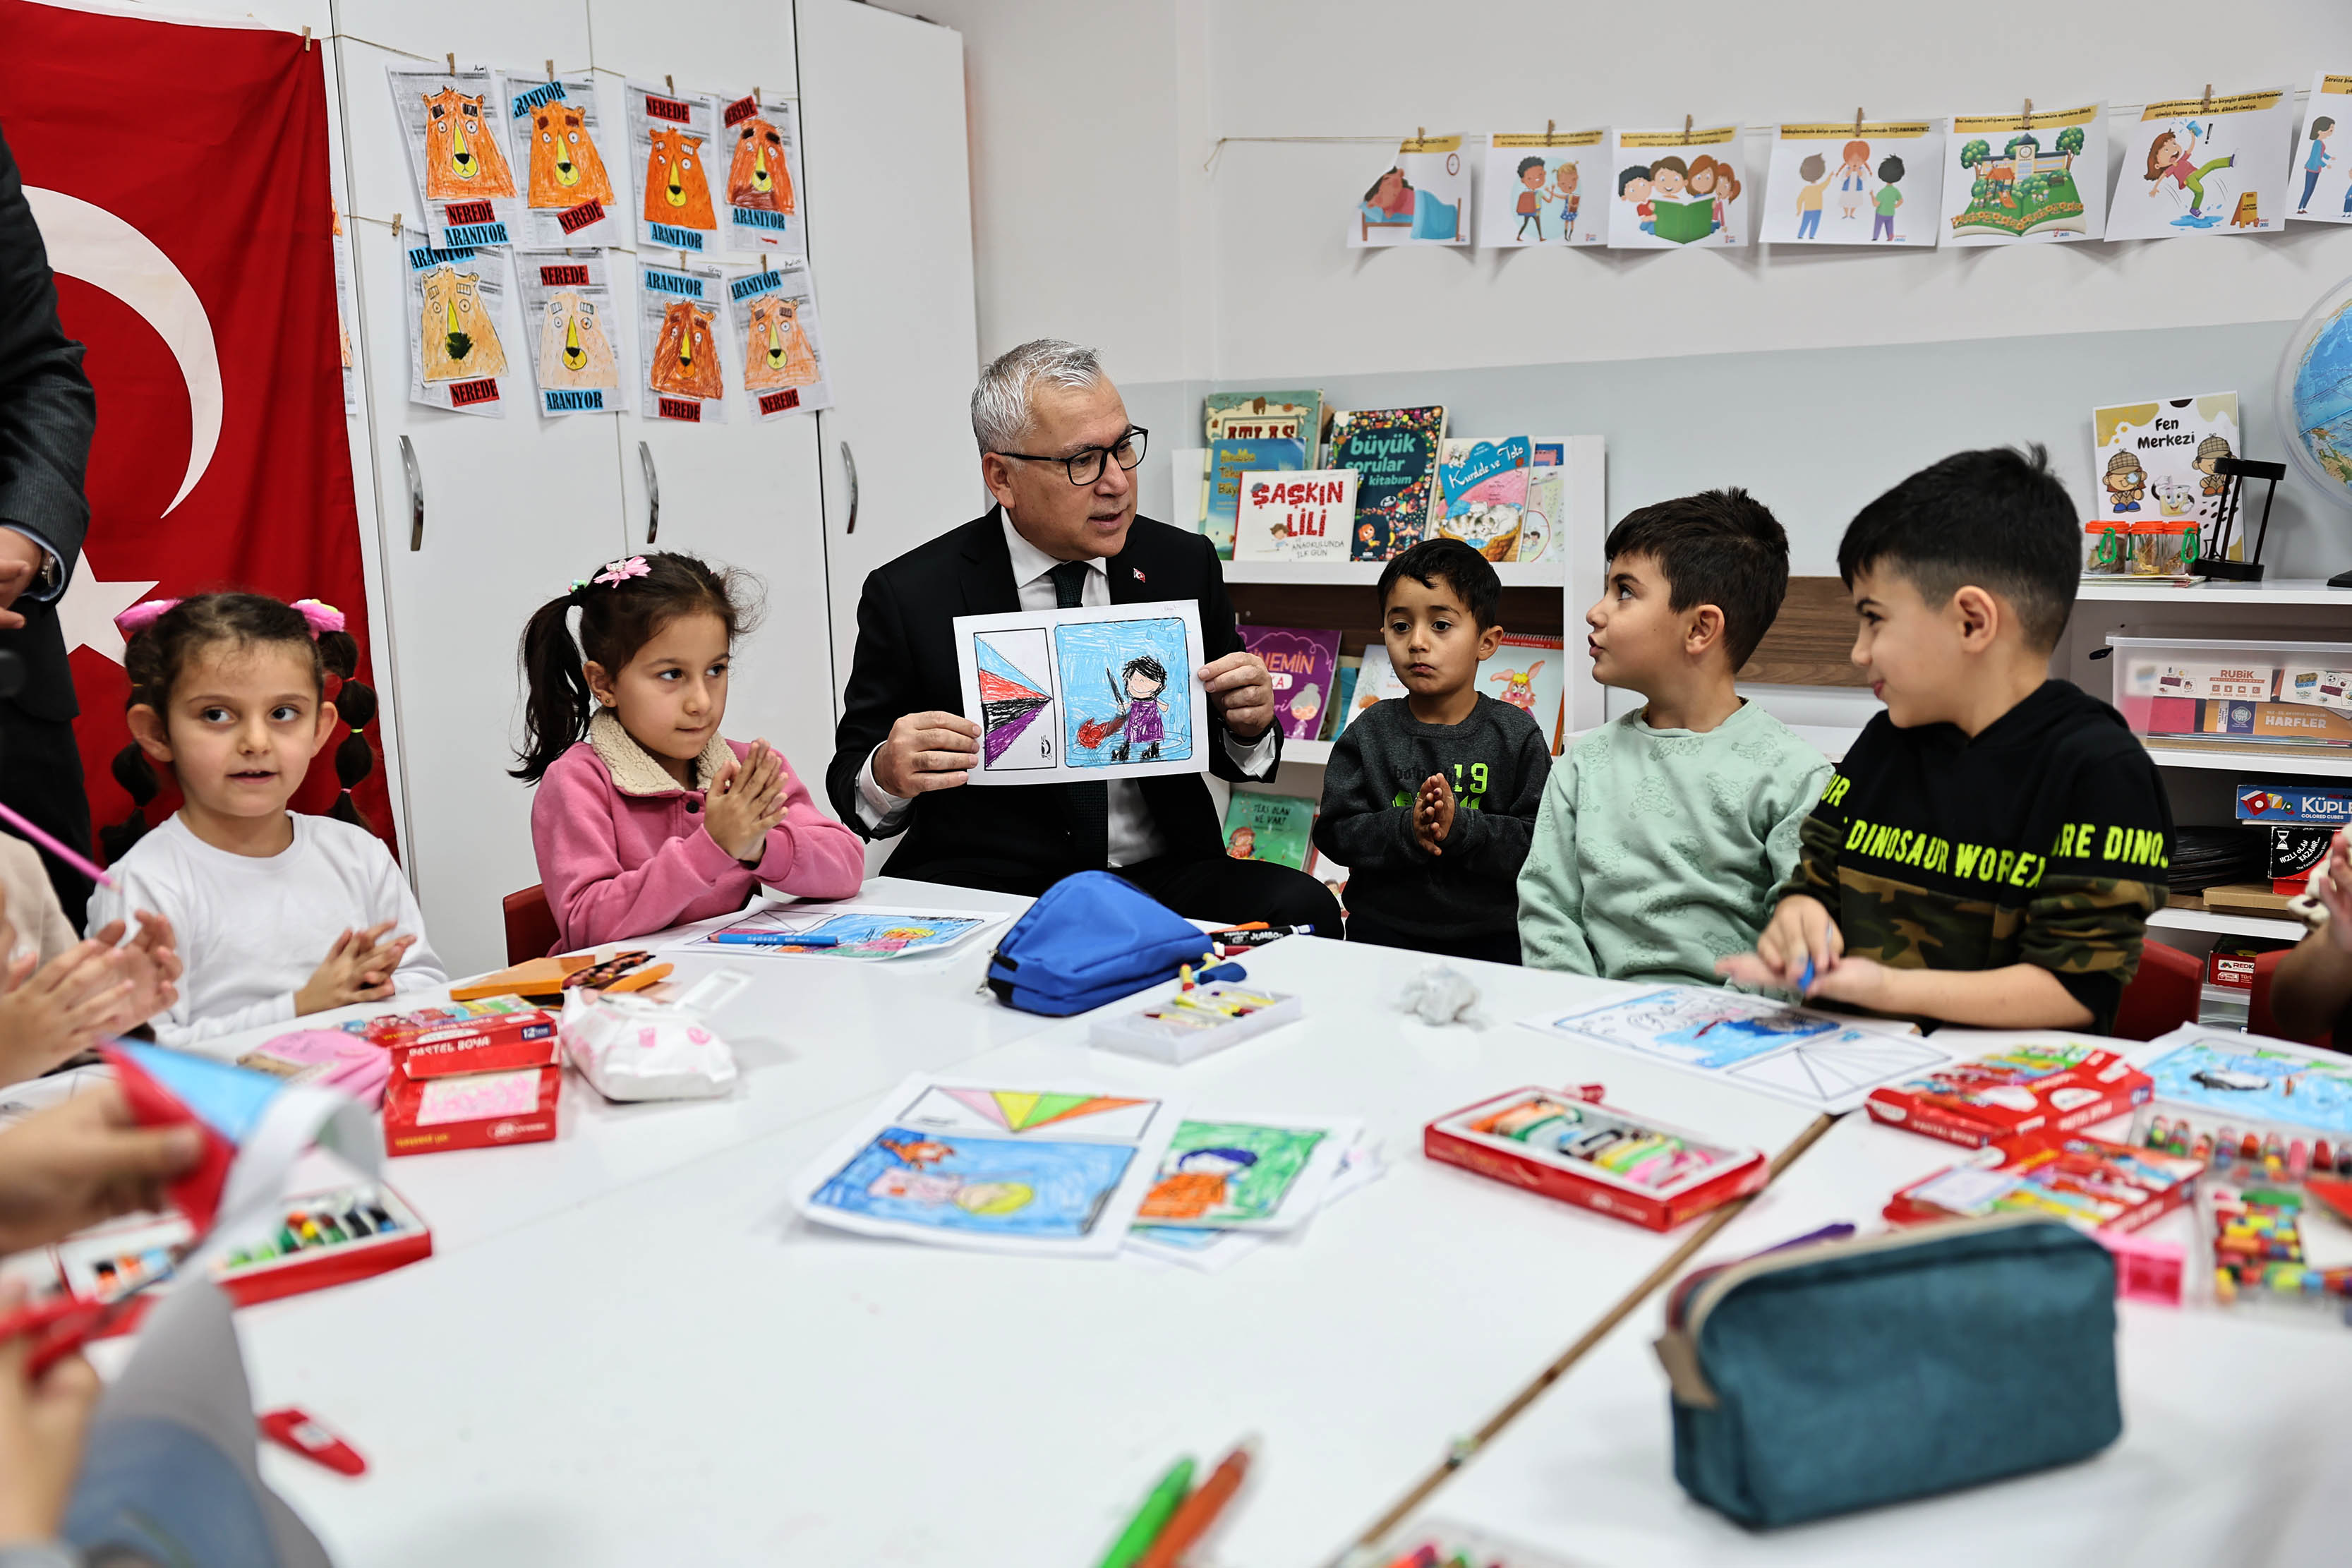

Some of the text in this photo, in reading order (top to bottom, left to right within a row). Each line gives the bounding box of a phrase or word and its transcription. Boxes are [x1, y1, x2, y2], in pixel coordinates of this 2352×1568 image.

[514, 81, 566, 118] RANIYOR
[646, 99, 689, 121] NEREDE
[446, 203, 495, 225] NEREDE
[557, 201, 605, 233] NEREDE
[733, 208, 785, 229] ARANIYOR
[445, 224, 508, 247] ARANIYOR
[651, 224, 702, 249] ARANIYOR
[541, 266, 586, 285] NEREDE
[646, 272, 702, 296] ARANIYOR
[450, 379, 499, 404] NEREDE
[546, 391, 603, 411] ARANIYOR
[761, 391, 800, 414] NEREDE
[661, 400, 701, 421] NEREDE
[2154, 417, 2179, 430] Fen
[1350, 433, 1417, 459] büyük
[2137, 432, 2195, 450] Merkezi
[1345, 457, 1406, 473] sorular
[1448, 462, 1490, 488] Kurdele
[1491, 459, 1502, 469] ve
[1368, 474, 1412, 486] kitabım
[1251, 481, 1344, 509] ŞAŞKIN
[1286, 507, 1327, 537] LİLİ
[2220, 670, 2255, 679] RUBiK
[2264, 716, 2327, 729] HARFLER
[1454, 763, 1489, 794] 19
[1845, 819, 1949, 874] DINOSAUR
[2103, 825, 2169, 869] DINO
[2279, 839, 2309, 864] HIZLI OLAN
[2303, 858, 2315, 868] Fastest
[2314, 849, 2324, 860] Person
